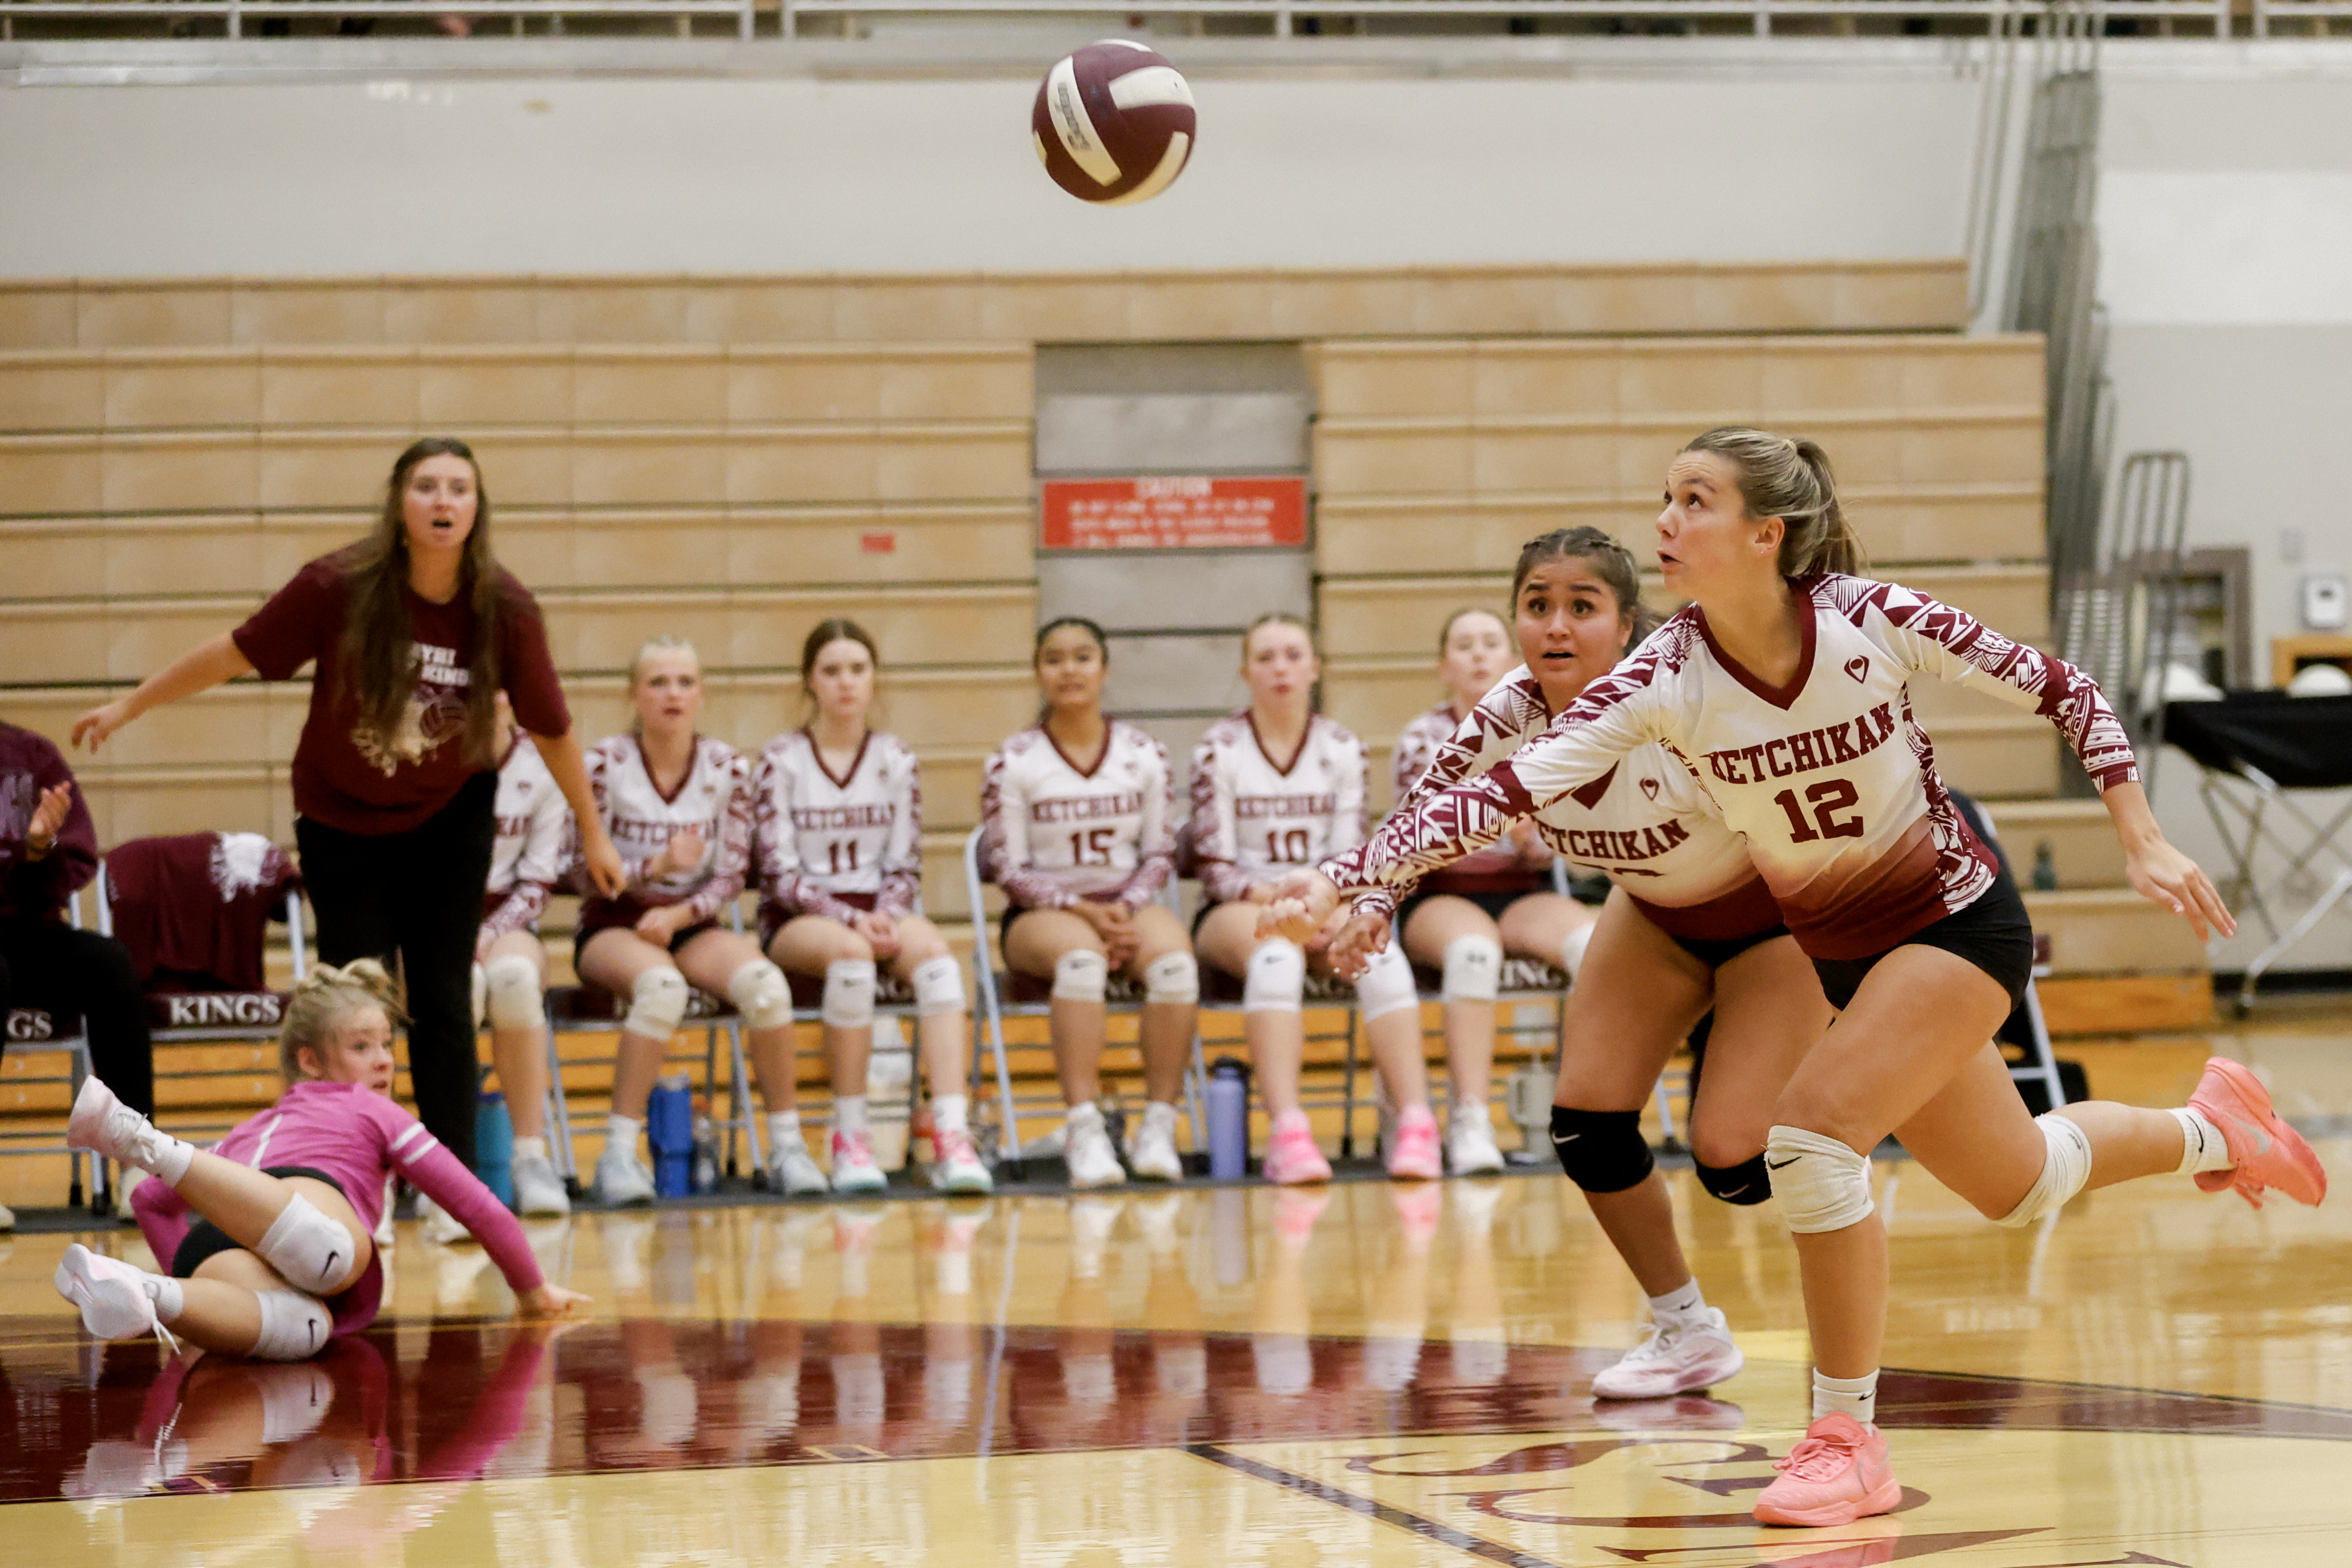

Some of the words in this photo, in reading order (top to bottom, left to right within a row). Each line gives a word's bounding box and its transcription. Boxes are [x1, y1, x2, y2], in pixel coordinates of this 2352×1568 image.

[1700, 702, 1895, 784] KETCHIKAN
[1774, 779, 1864, 843] 12
[829, 838, 857, 874] 11
[1071, 828, 1115, 866] 15
[1267, 830, 1308, 864] 10
[1538, 818, 1690, 860] ETCHIKAN
[169, 995, 281, 1024] KINGS
